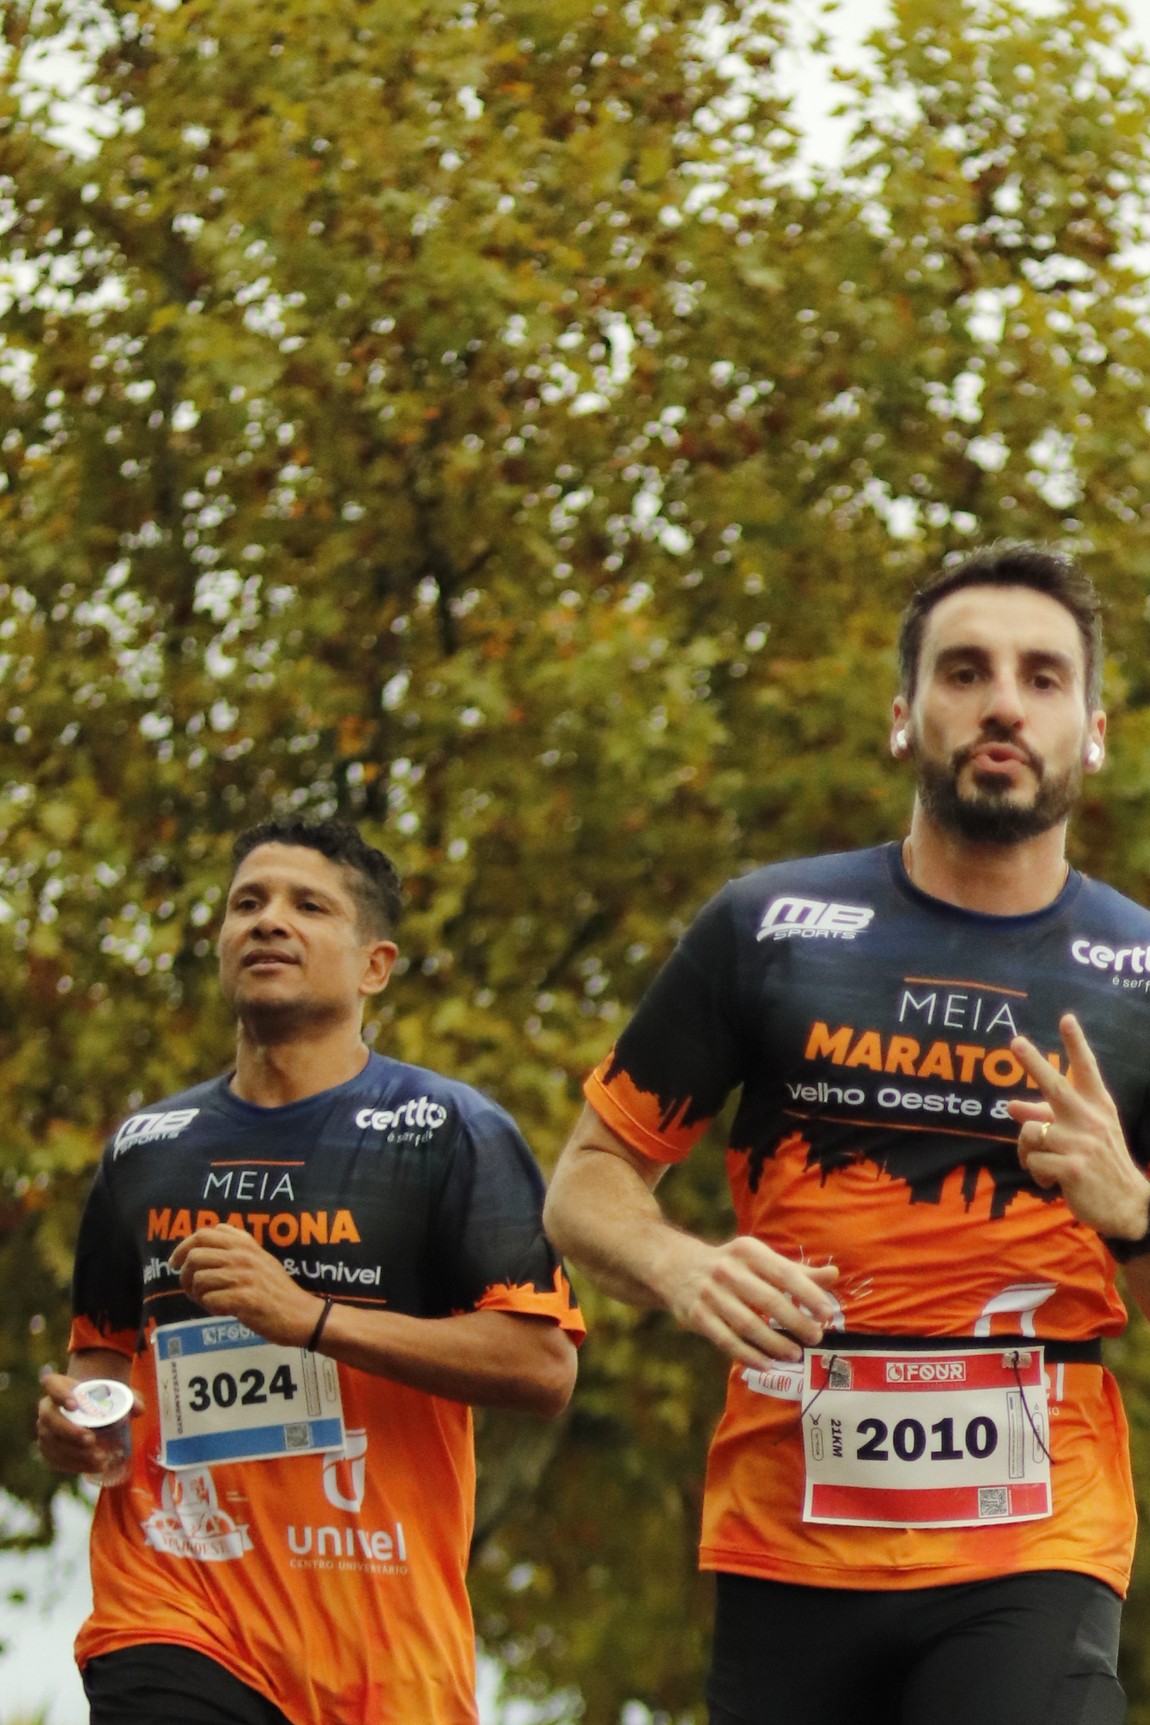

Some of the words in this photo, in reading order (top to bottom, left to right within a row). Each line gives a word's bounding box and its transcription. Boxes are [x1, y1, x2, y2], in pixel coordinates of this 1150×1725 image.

[759, 897, 875, 931] MB
[773, 928, 857, 941] SPORTS
[899, 990, 1018, 1036] MEIA
[355, 1095, 448, 1131] certto
[785, 1082, 865, 1105] Velho
[877, 1087, 983, 1117] Oeste
[990, 1100, 1013, 1120] &
[203, 1170, 295, 1201] MEIA
[283, 1258, 300, 1276] &
[301, 1260, 382, 1285] Univel
[217, 1324, 255, 1343] FOU
[188, 1363, 298, 1413] 3024
[906, 1362, 963, 1381] FOUR
[830, 1418, 843, 1458] 21KM
[856, 1416, 998, 1462] 2010
